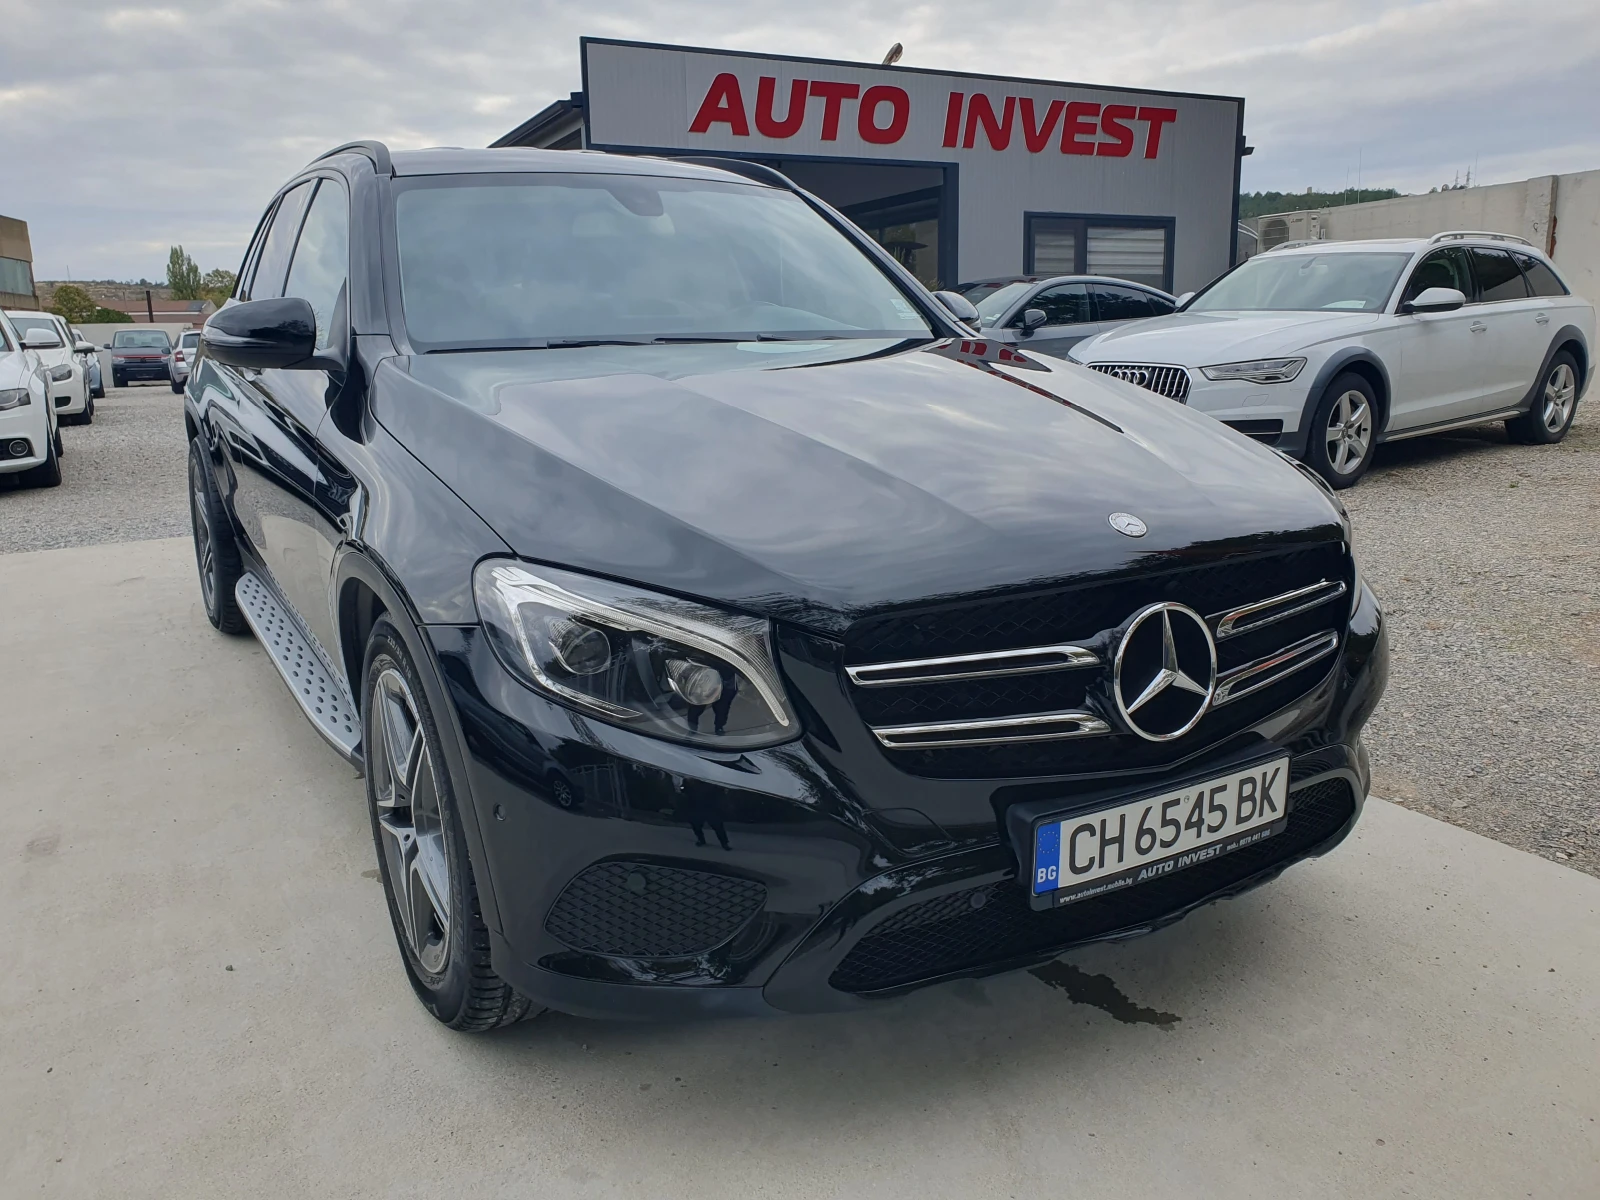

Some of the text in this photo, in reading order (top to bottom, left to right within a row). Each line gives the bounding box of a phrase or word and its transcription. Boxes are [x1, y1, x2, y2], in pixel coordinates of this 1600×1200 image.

[688, 73, 1177, 159] AUTO INVEST
[1068, 766, 1281, 876] CH 6545 BK
[1036, 865, 1057, 883] BG
[1137, 860, 1174, 881] AUTO
[1177, 843, 1223, 867] INVEST
